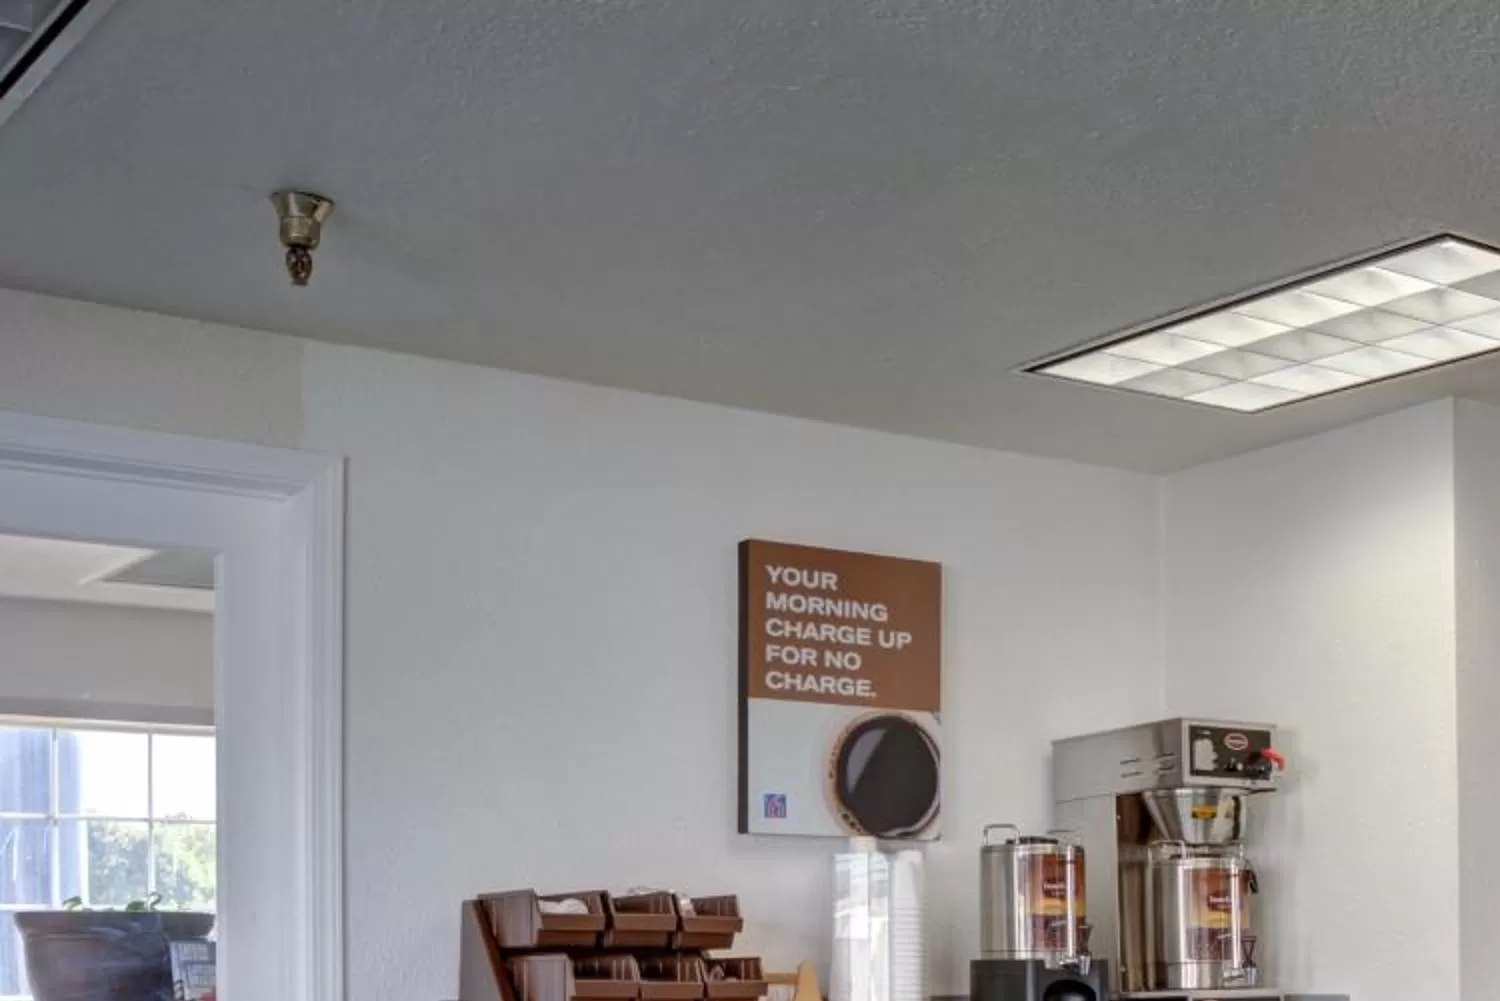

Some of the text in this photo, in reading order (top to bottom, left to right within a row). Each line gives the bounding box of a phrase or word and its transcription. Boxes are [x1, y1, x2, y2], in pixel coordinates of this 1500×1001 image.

[765, 565, 838, 591] YOUR
[766, 591, 888, 622] MORNING
[765, 617, 912, 650] CHARGE UP
[765, 644, 862, 670] FOR NO
[765, 671, 877, 698] CHARGE.
